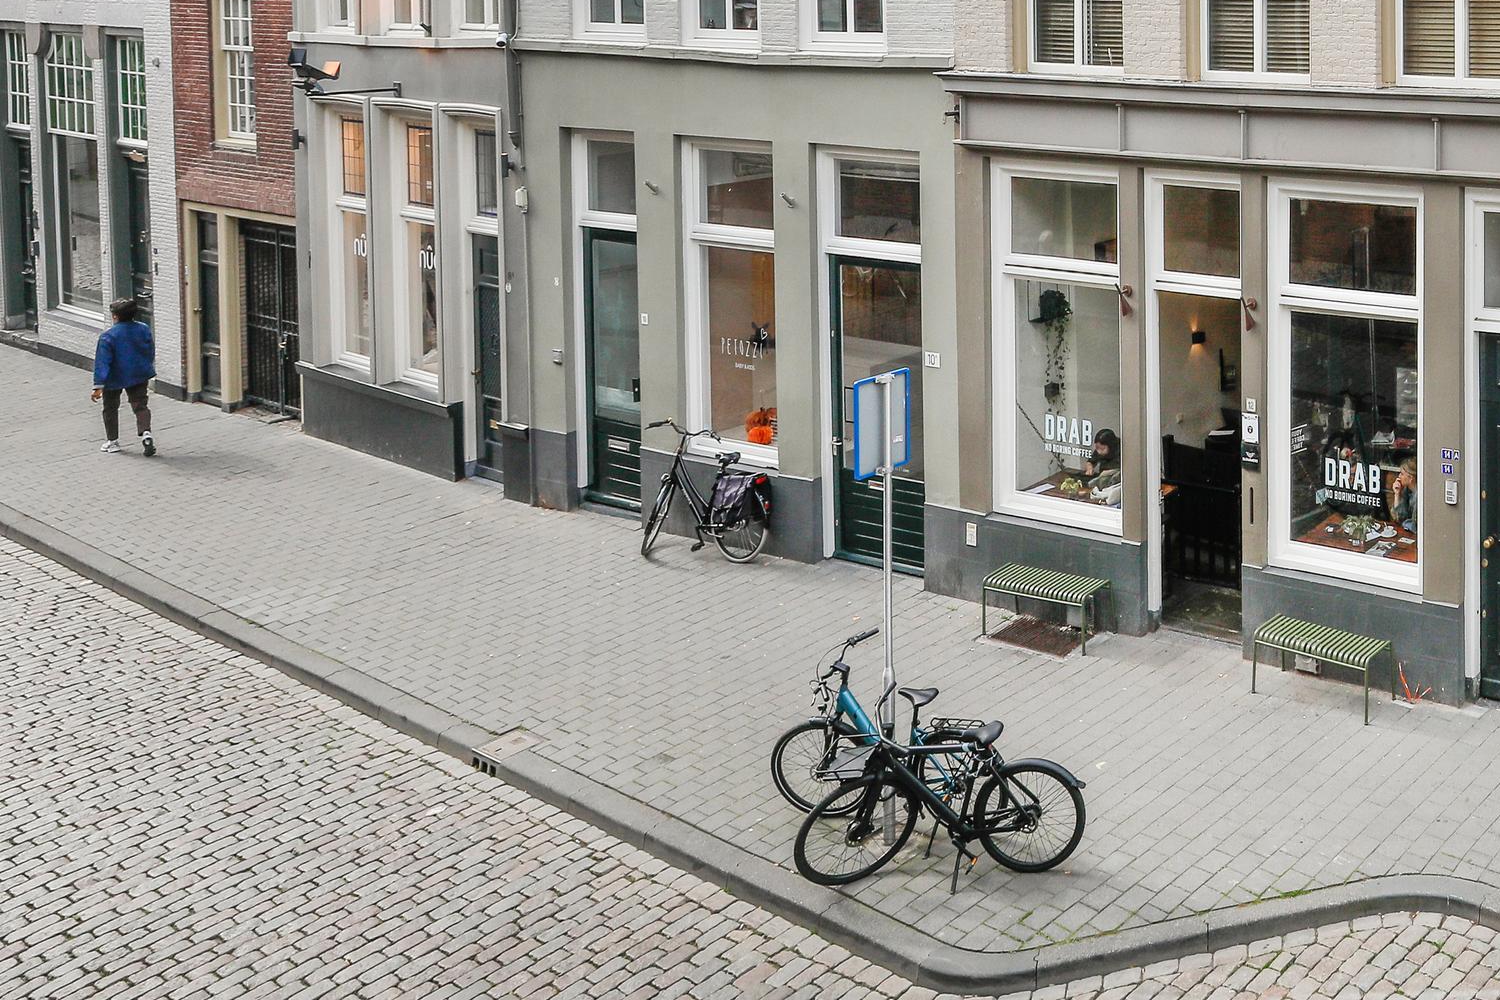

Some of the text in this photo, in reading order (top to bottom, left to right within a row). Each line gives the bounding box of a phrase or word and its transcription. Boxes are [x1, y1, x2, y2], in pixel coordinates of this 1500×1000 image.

[1044, 413, 1092, 447] DRAB
[1052, 443, 1071, 455] BORING
[1071, 446, 1092, 459] COFFEE
[1324, 457, 1381, 494] DRAB
[1333, 490, 1356, 503] BORING
[1356, 494, 1381, 507] COFFEE
